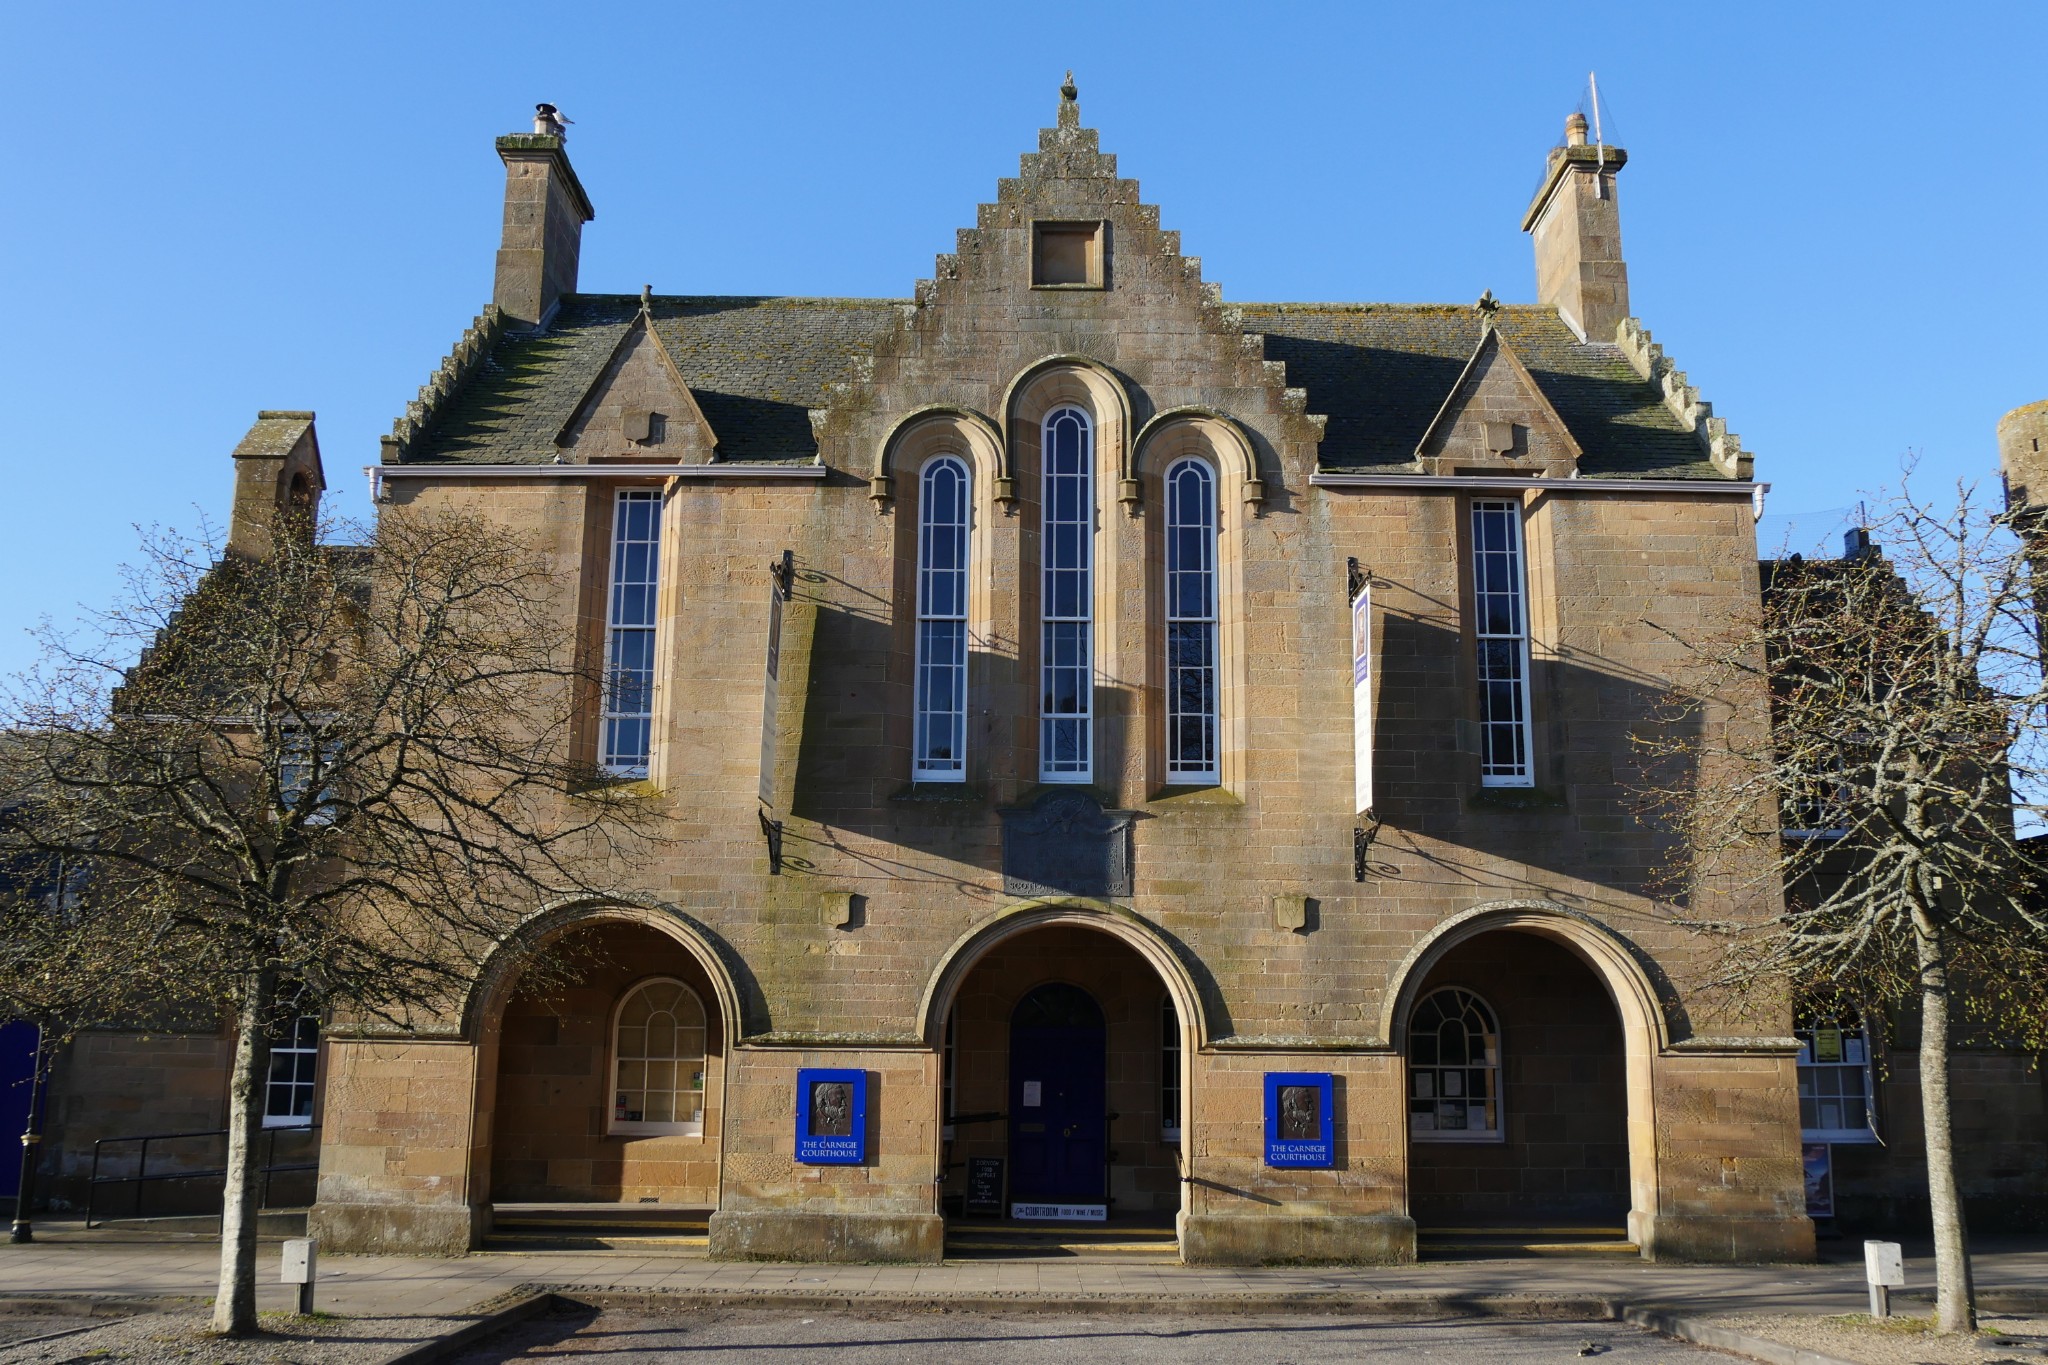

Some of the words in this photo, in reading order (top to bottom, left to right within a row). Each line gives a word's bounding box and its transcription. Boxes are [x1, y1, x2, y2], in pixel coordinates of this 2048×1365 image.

[827, 895, 845, 904] MD
[829, 905, 844, 913] CC
[819, 1141, 857, 1149] CARNEGIE
[1288, 1145, 1326, 1153] CARNEGIE
[801, 1149, 857, 1157] COURTHOUSE
[1270, 1153, 1326, 1161] COURTHOUSE
[1025, 1206, 1059, 1217] COURTROOM
